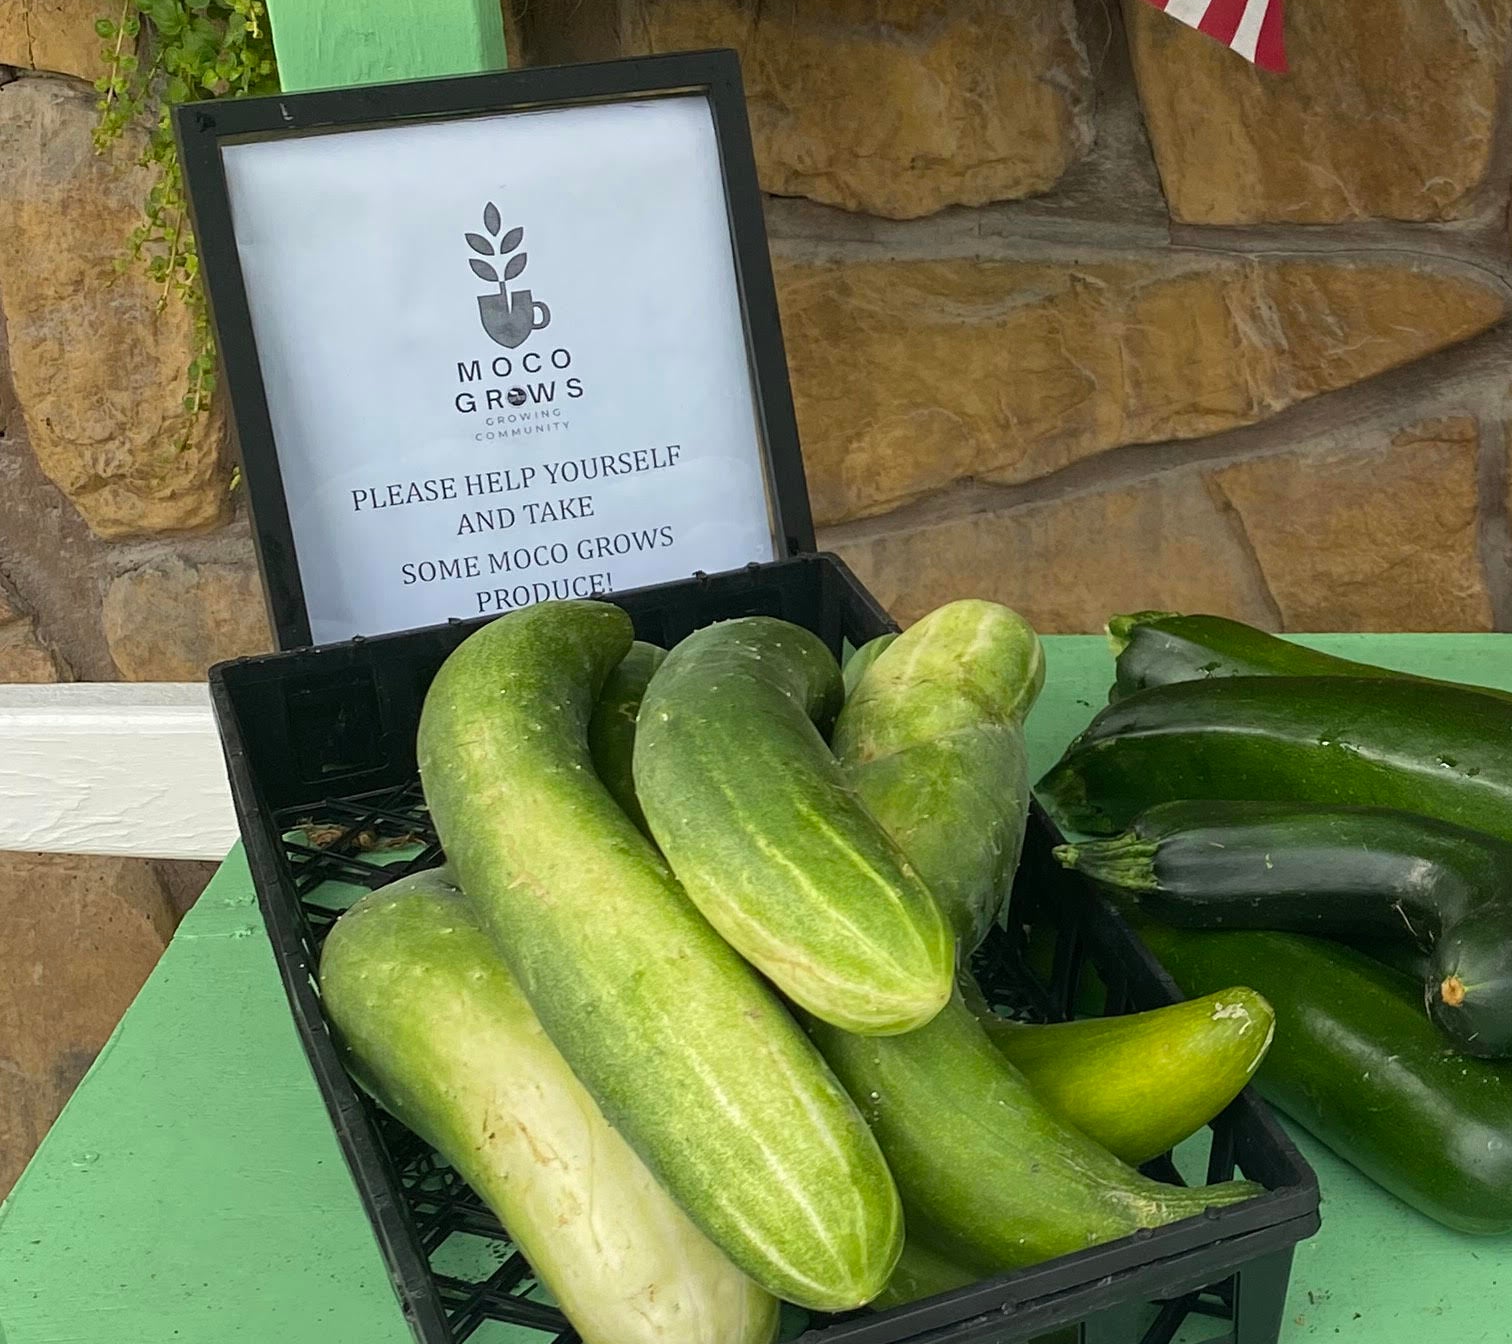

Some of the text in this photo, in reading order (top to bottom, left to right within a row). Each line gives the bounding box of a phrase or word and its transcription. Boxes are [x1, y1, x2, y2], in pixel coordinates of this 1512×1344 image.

[457, 348, 571, 382] MOCO
[455, 378, 583, 413] GROWS
[475, 421, 570, 441] COMMUNITY
[485, 408, 561, 426] GROWING
[351, 445, 681, 511] PLEASE HELP YOURSELF
[456, 496, 595, 536] AND TAKE
[402, 526, 675, 585] SOME MOCO GROWS
[476, 572, 614, 613] PRODUCE!
